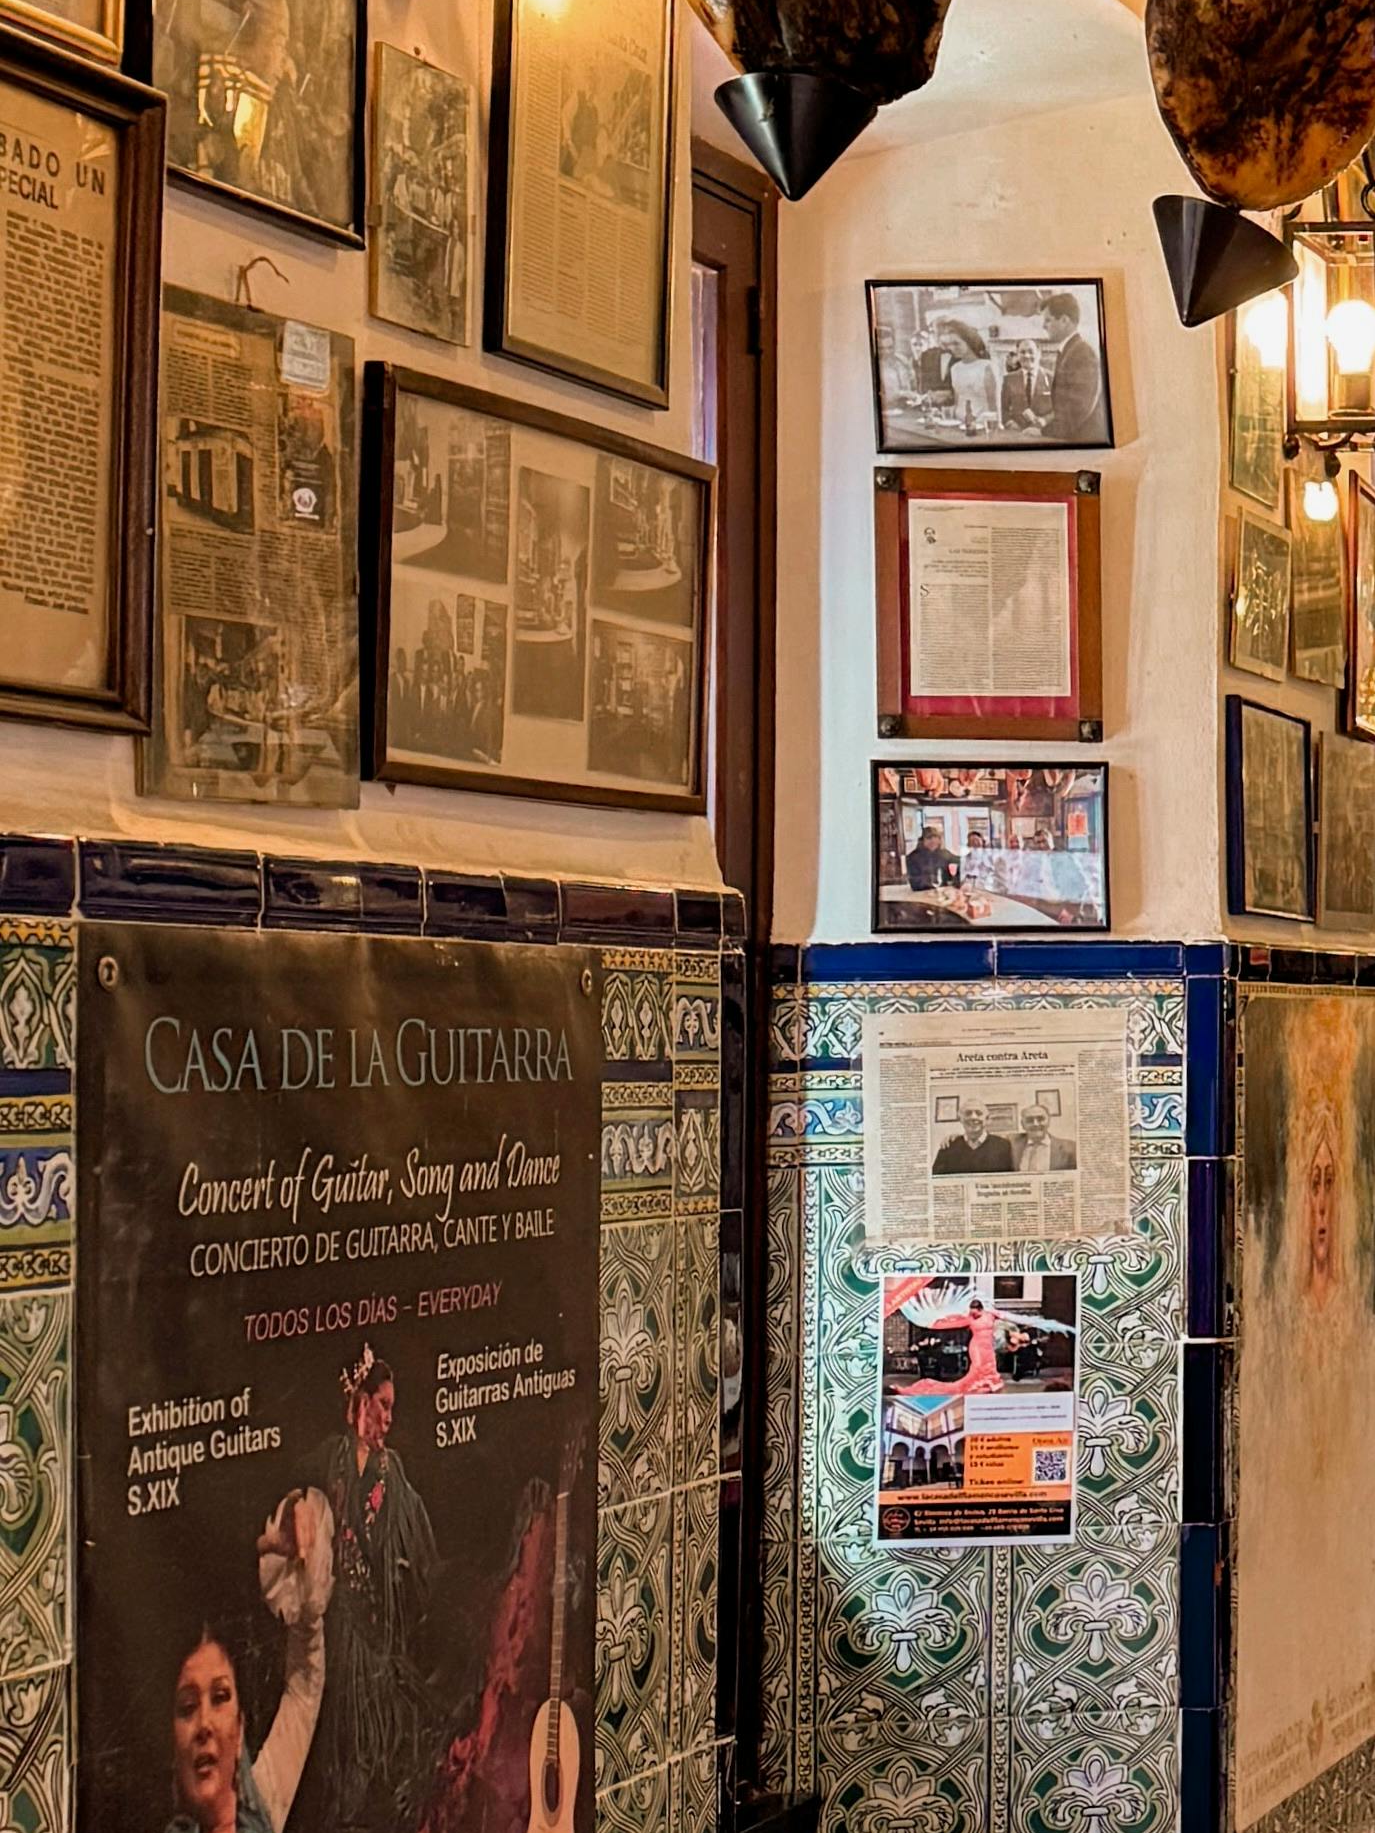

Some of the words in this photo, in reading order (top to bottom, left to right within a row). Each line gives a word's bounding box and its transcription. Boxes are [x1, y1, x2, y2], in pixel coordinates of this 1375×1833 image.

[76, 162, 104, 196] UN
[143, 1016, 267, 1095] CASA
[280, 1028, 337, 1091] DE
[348, 1028, 391, 1088] LA
[396, 1017, 574, 1087] GUITARRA
[957, 1052, 985, 1063] Areta
[986, 1052, 1019, 1062] contra
[1021, 1050, 1049, 1061] Areta
[178, 1159, 276, 1216] Concert
[280, 1146, 312, 1225] of
[311, 1154, 394, 1214] Guitar,
[400, 1146, 455, 1224] Song
[459, 1133, 508, 1192] and
[507, 1140, 561, 1189] Dance
[189, 1235, 310, 1278] CONCIERTO
[314, 1232, 341, 1263] DE
[346, 1223, 440, 1258] GUITARRA,
[443, 1215, 498, 1249] CANTE
[500, 1215, 512, 1241] Y
[515, 1208, 555, 1238] BAILE
[243, 1307, 310, 1342] TODOS
[314, 1301, 352, 1334] LOS
[356, 1292, 398, 1328] DÍAS
[416, 1280, 503, 1319] EVERYDAY
[436, 1342, 522, 1381] Exposición
[523, 1338, 544, 1364] de
[127, 1396, 226, 1439] Exhibition
[230, 1387, 252, 1419] of
[435, 1379, 510, 1415] Guitarras
[512, 1365, 577, 1401] Antiguas
[127, 1438, 206, 1478] Antique
[210, 1423, 282, 1459] Guitars
[435, 1414, 478, 1450] S.XIX
[127, 1475, 181, 1517] S.XIX
